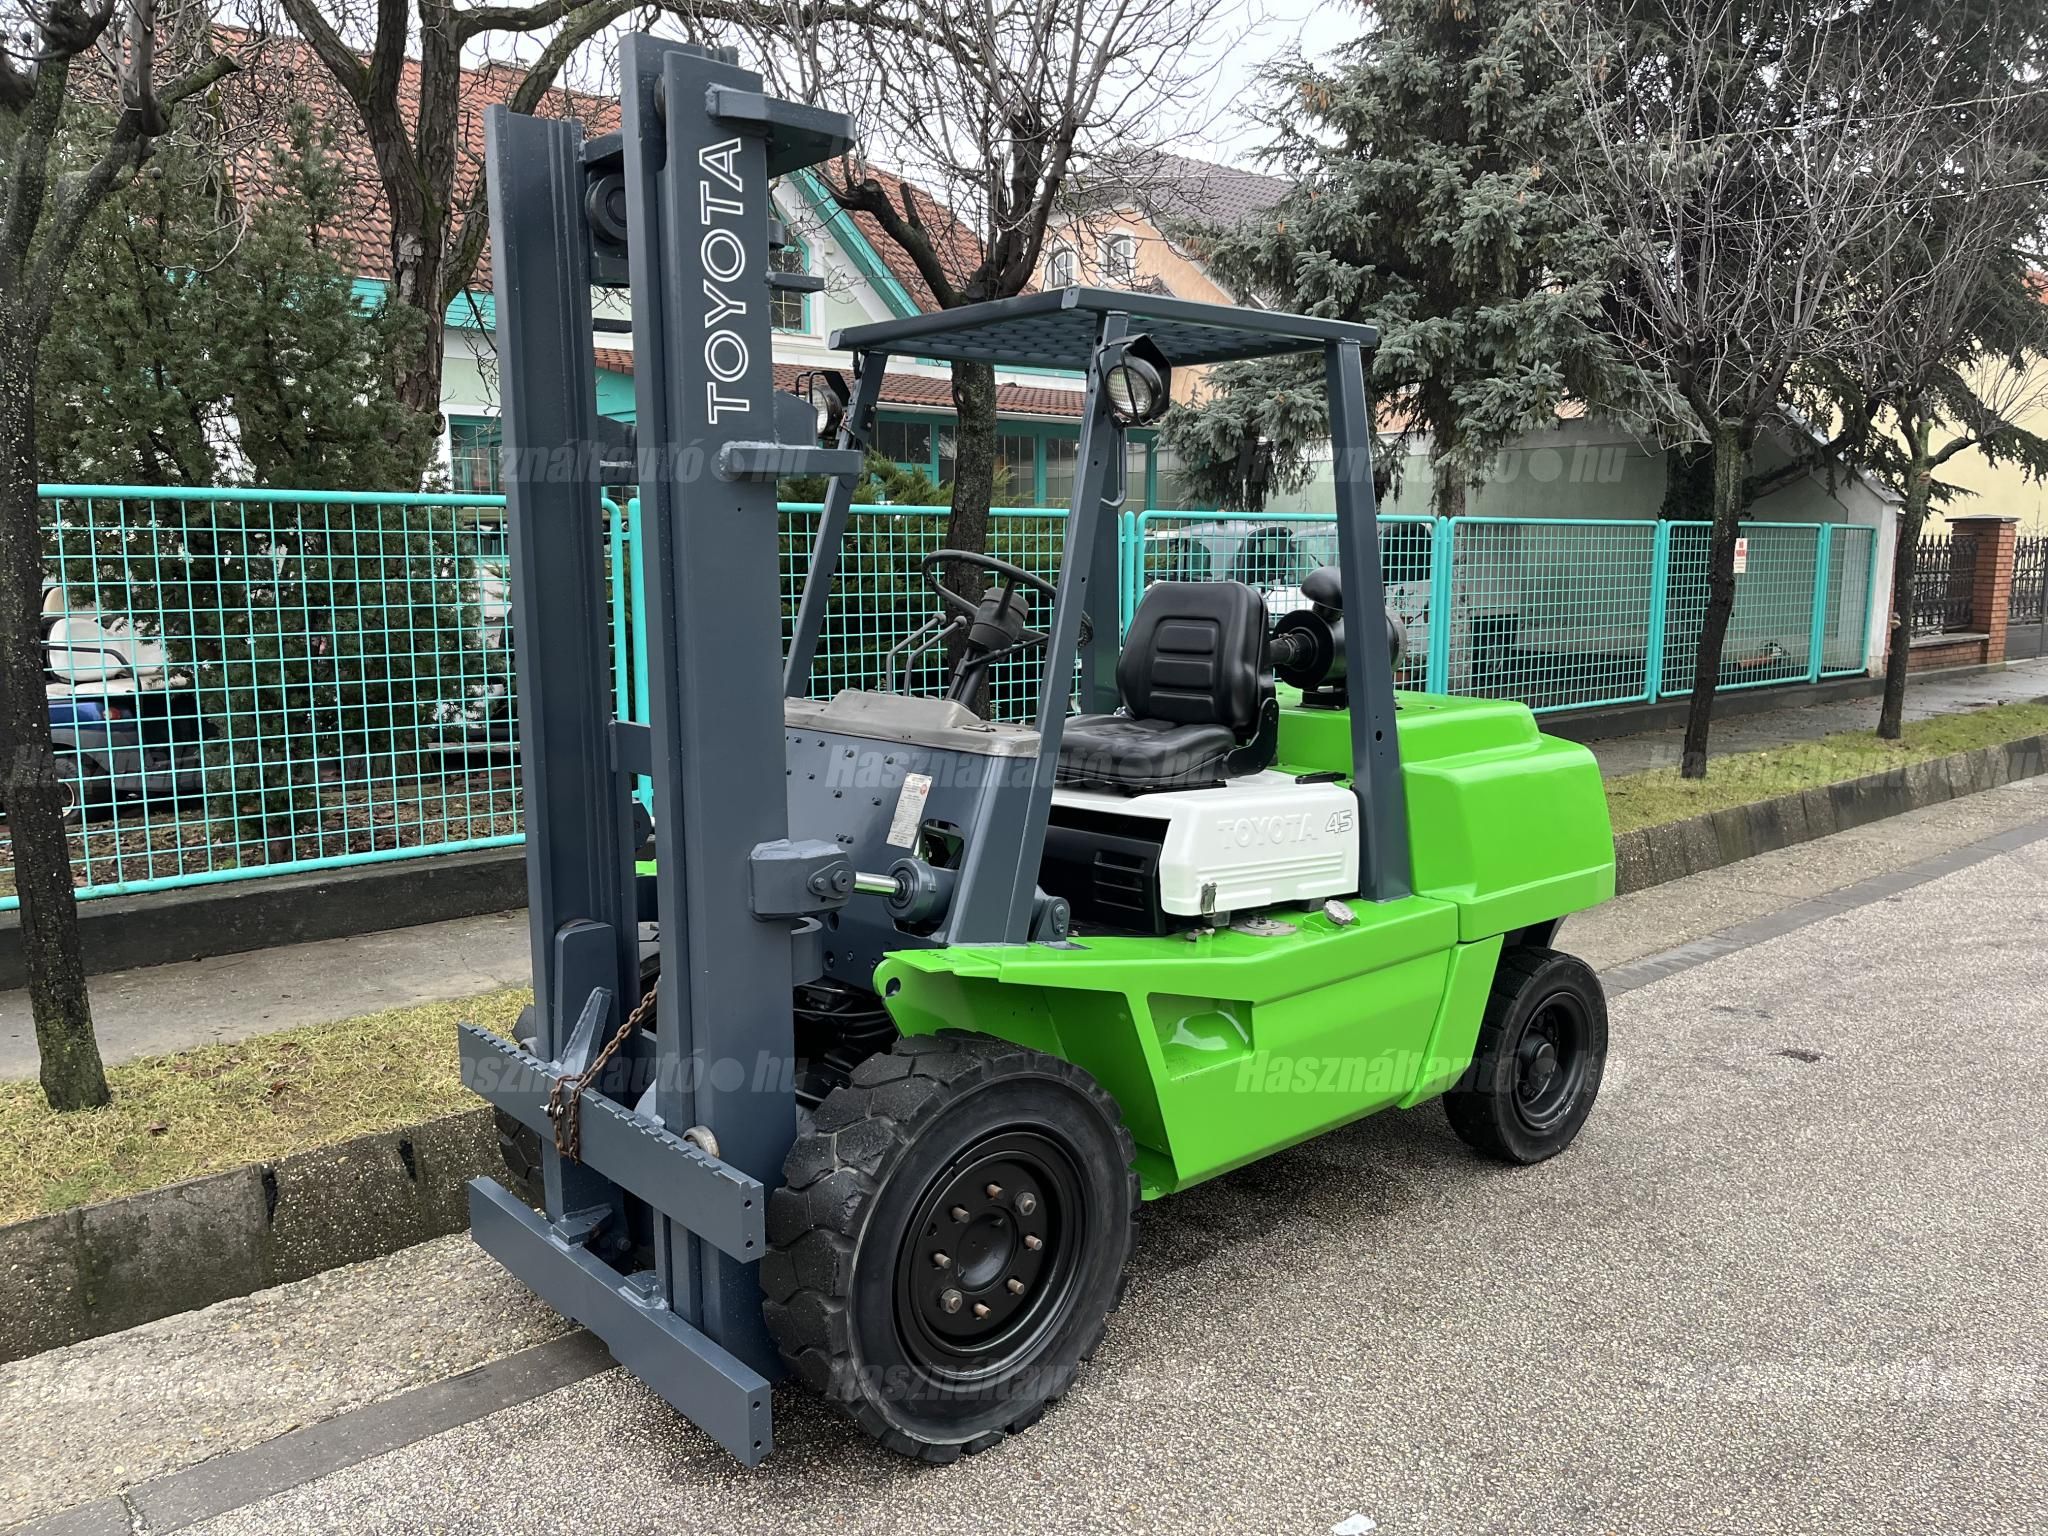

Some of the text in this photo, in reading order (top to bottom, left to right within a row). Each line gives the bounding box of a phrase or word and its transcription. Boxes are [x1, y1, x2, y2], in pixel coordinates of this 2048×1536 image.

[699, 137, 751, 425] TOYOTA
[1216, 809, 1354, 850] TOYOTA 45
